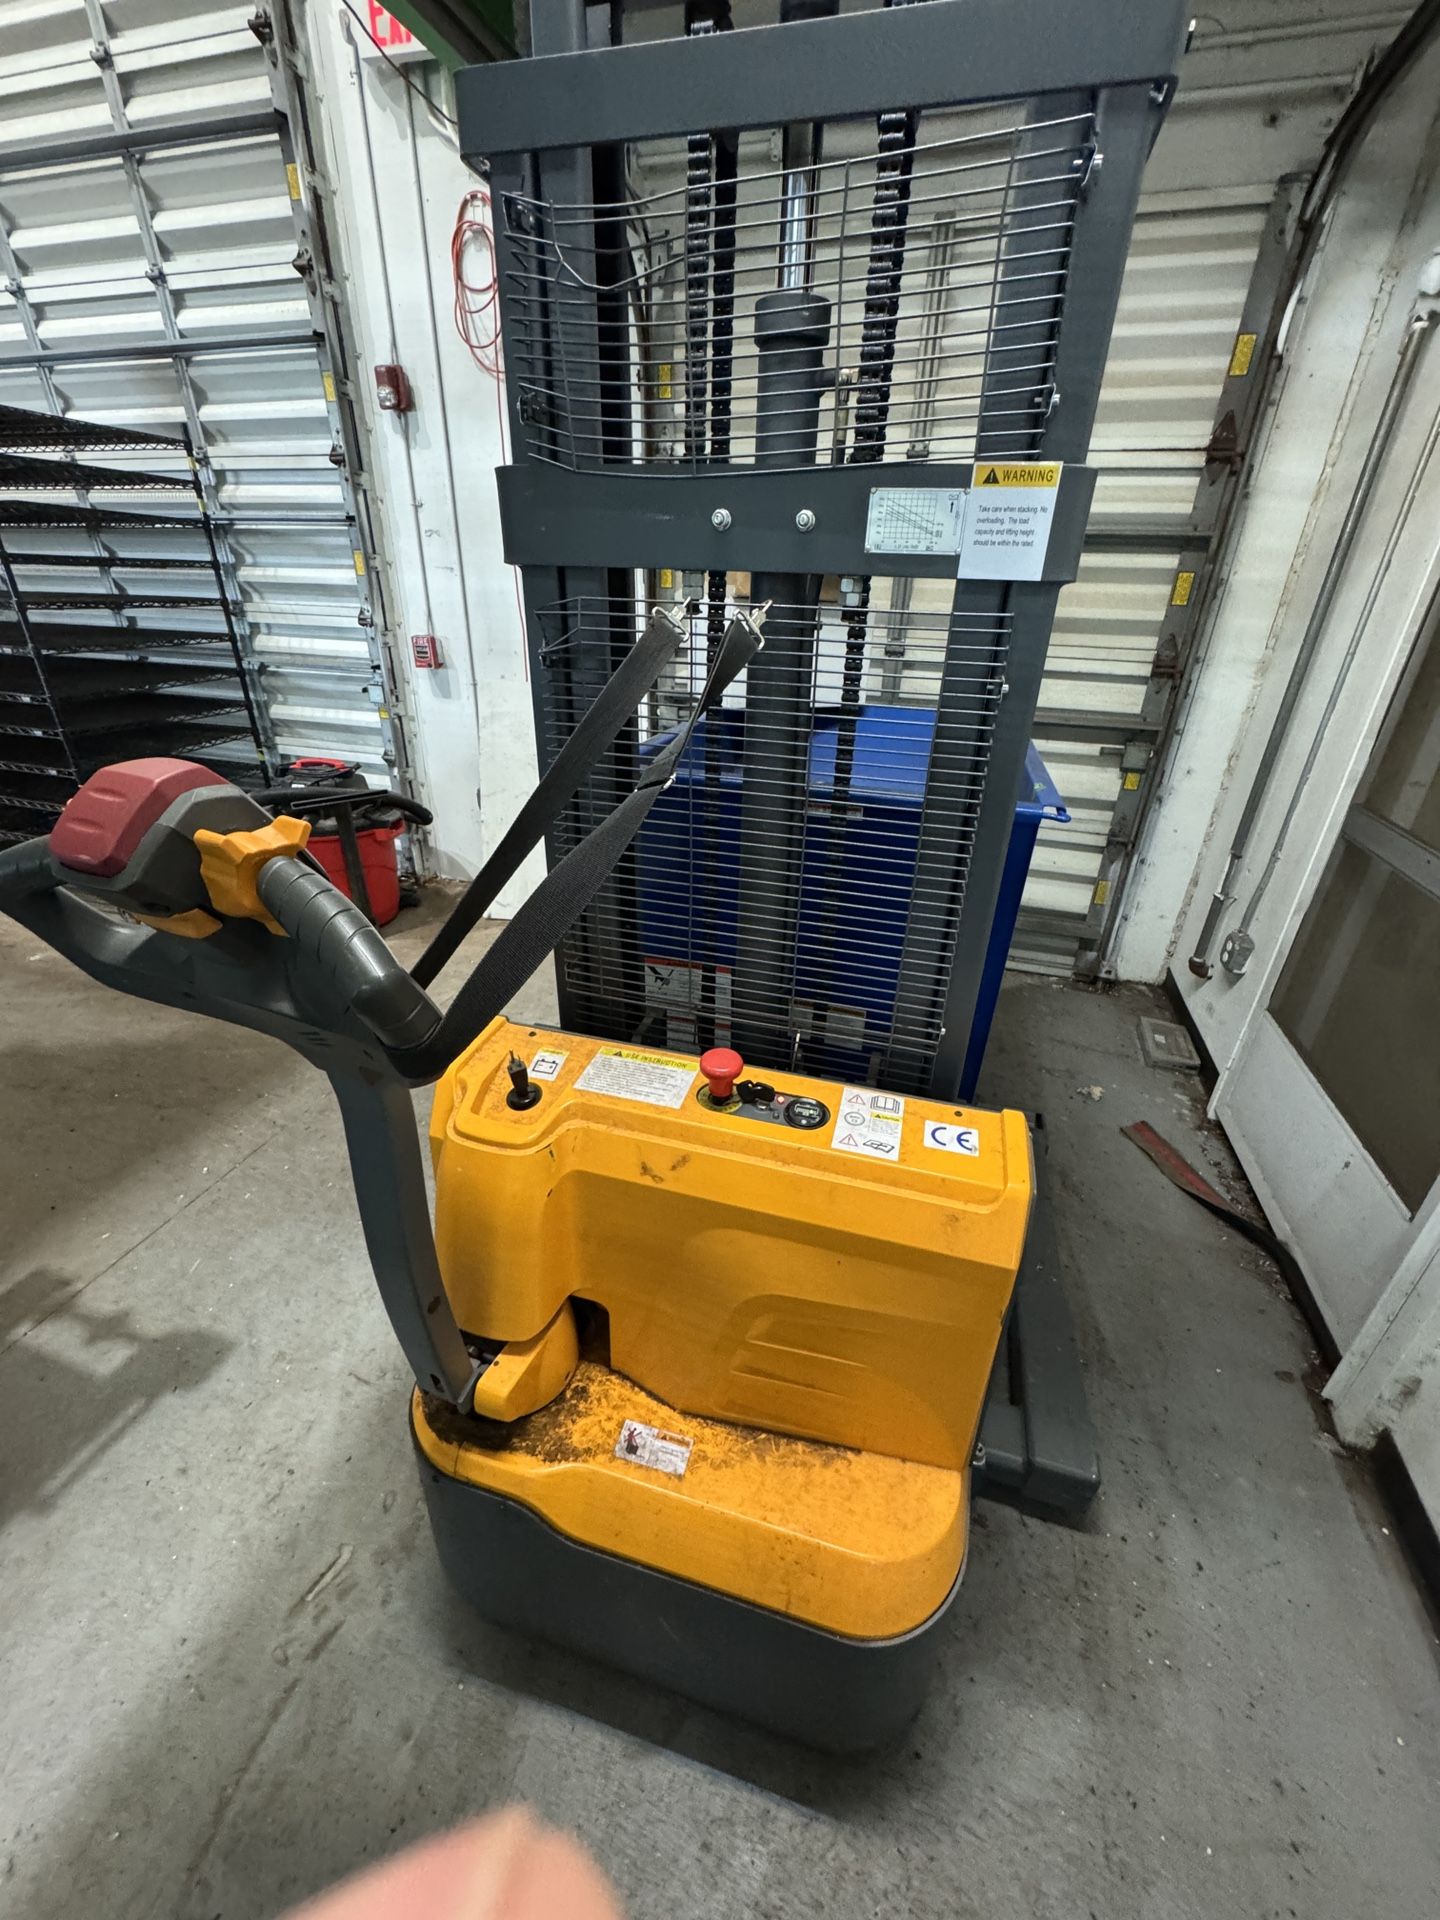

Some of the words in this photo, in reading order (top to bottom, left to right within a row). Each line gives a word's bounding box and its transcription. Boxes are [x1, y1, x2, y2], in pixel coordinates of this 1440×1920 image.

[1002, 469, 1054, 482] WARNING
[978, 505, 990, 513] Take
[1003, 505, 1017, 513] when
[1040, 505, 1048, 513] No
[1008, 516, 1018, 524] The
[974, 528, 995, 536] capacity
[1005, 528, 1019, 537] lifting
[1019, 529, 1035, 537] height
[931, 1126, 973, 1151] CE
